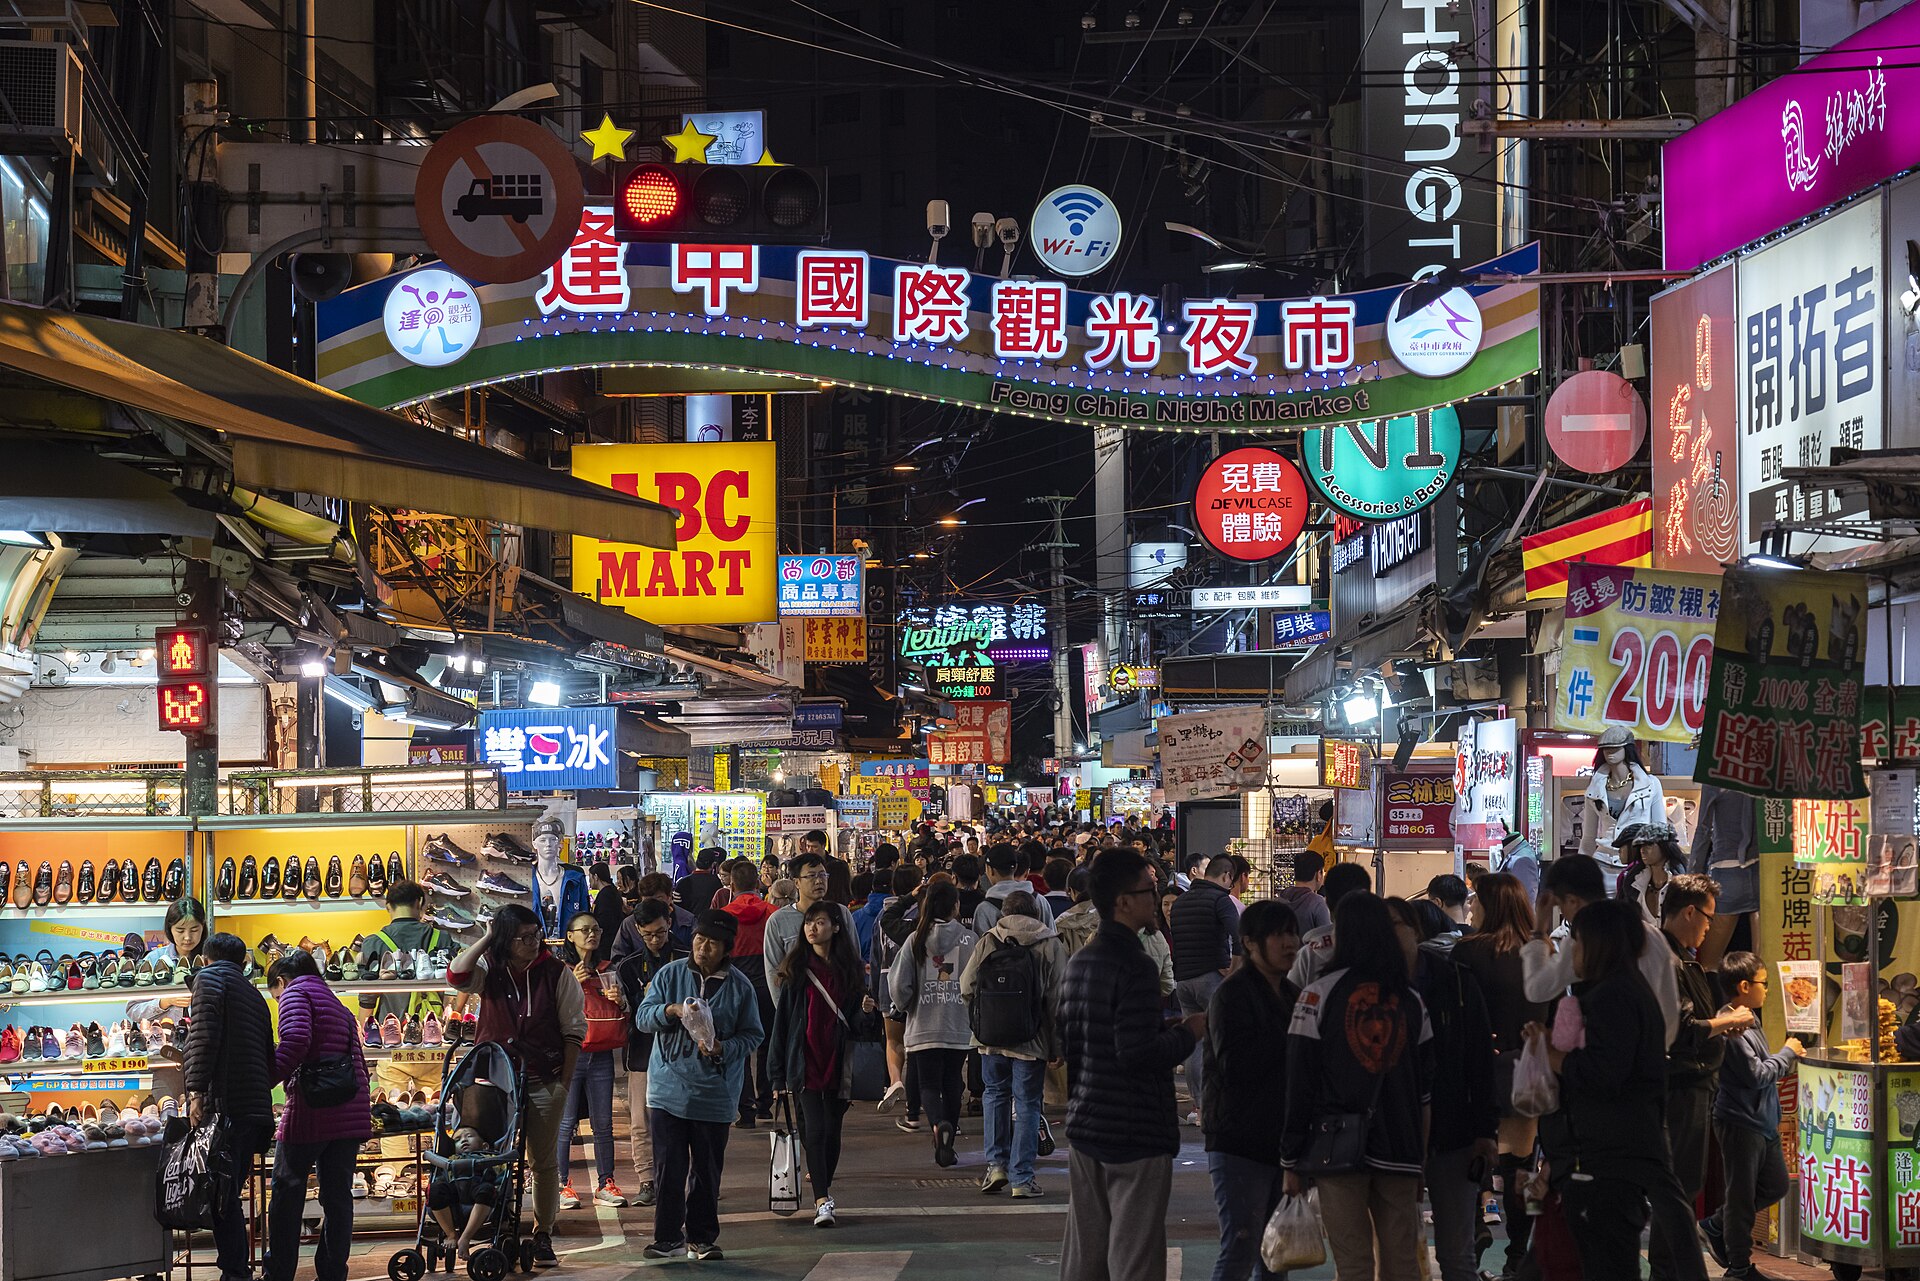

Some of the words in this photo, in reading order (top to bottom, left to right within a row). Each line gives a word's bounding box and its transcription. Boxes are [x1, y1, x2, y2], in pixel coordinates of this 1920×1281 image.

[1042, 236, 1110, 259] Wi-Fi
[448, 303, 472, 315] 觀光
[448, 313, 472, 325] 夜市
[1409, 341, 1462, 351] 臺中市政府
[1747, 265, 1875, 436] 開拓者
[992, 381, 1070, 416] Feng
[1074, 394, 1149, 421] Chia
[1155, 398, 1244, 425] Night
[1247, 388, 1370, 421] Market
[1221, 462, 1282, 494] 免費
[1320, 474, 1400, 515] Accessories
[1403, 495, 1416, 509] &
[1415, 469, 1449, 503] Bags
[1210, 497, 1293, 511] DEVILCASE
[1221, 512, 1283, 544] 體驗
[598, 550, 752, 598] MART
[782, 558, 857, 581] 尚の都
[781, 583, 859, 600] 商品專賣
[1199, 592, 1209, 602] 3C
[1213, 591, 1233, 602] 配件
[1237, 591, 1256, 601] 包膜
[1570, 579, 1618, 613] 免燙
[1275, 612, 1317, 640] 男裝
[936, 667, 996, 683] 肩頸舒壓
[1724, 663, 1747, 708] 逢甲
[165, 685, 203, 725] 62
[1753, 677, 1809, 711] 100%
[1813, 677, 1858, 718] 全素
[958, 706, 985, 727] 按摩
[442, 750, 464, 760] SALE
[930, 741, 985, 763] 肩頸舒壓
[1709, 709, 1855, 794] 鹽酥菇
[766, 813, 781, 821] SALE
[783, 817, 796, 825] 250
[924, 981, 951, 991] SPIRIT
[952, 981, 961, 990] IS
[919, 994, 935, 1005] NOT
[417, 1052, 449, 1061] $19
[84, 1061, 106, 1070] 特價
[1853, 1073, 1868, 1087] 100
[1853, 1087, 1868, 1101] 100
[1853, 1102, 1868, 1116] 200
[1853, 1117, 1869, 1130] 50
[1896, 1152, 1913, 1188] 逢甲
